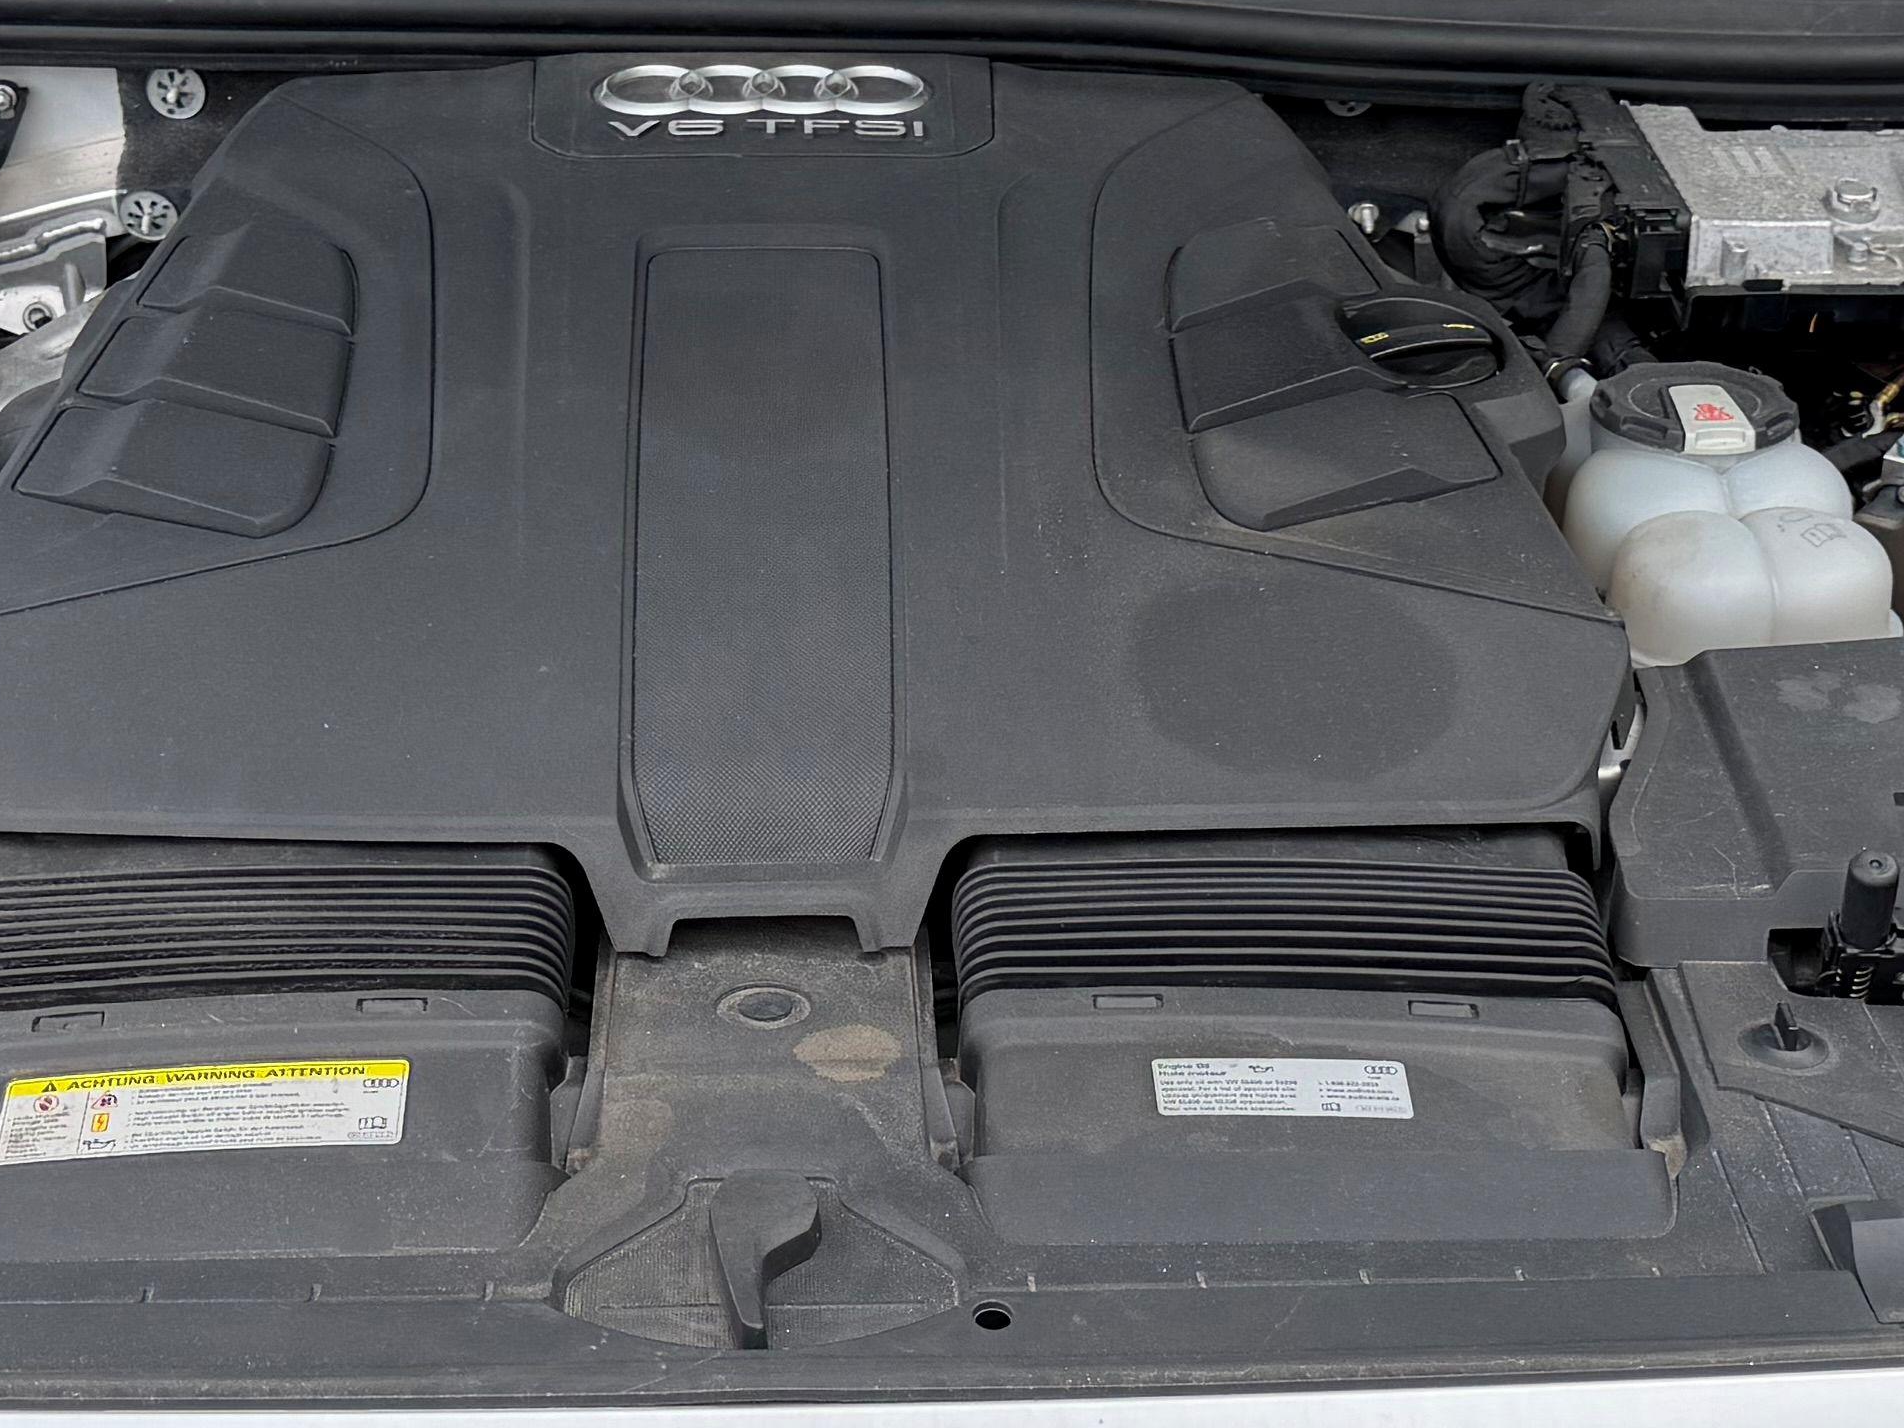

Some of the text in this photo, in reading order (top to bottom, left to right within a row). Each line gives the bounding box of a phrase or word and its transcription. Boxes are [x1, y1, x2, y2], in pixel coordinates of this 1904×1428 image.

[607, 119, 924, 137] V6 TFSI
[66, 1066, 365, 1090] ACHTUNG WARNING ATTENTION
